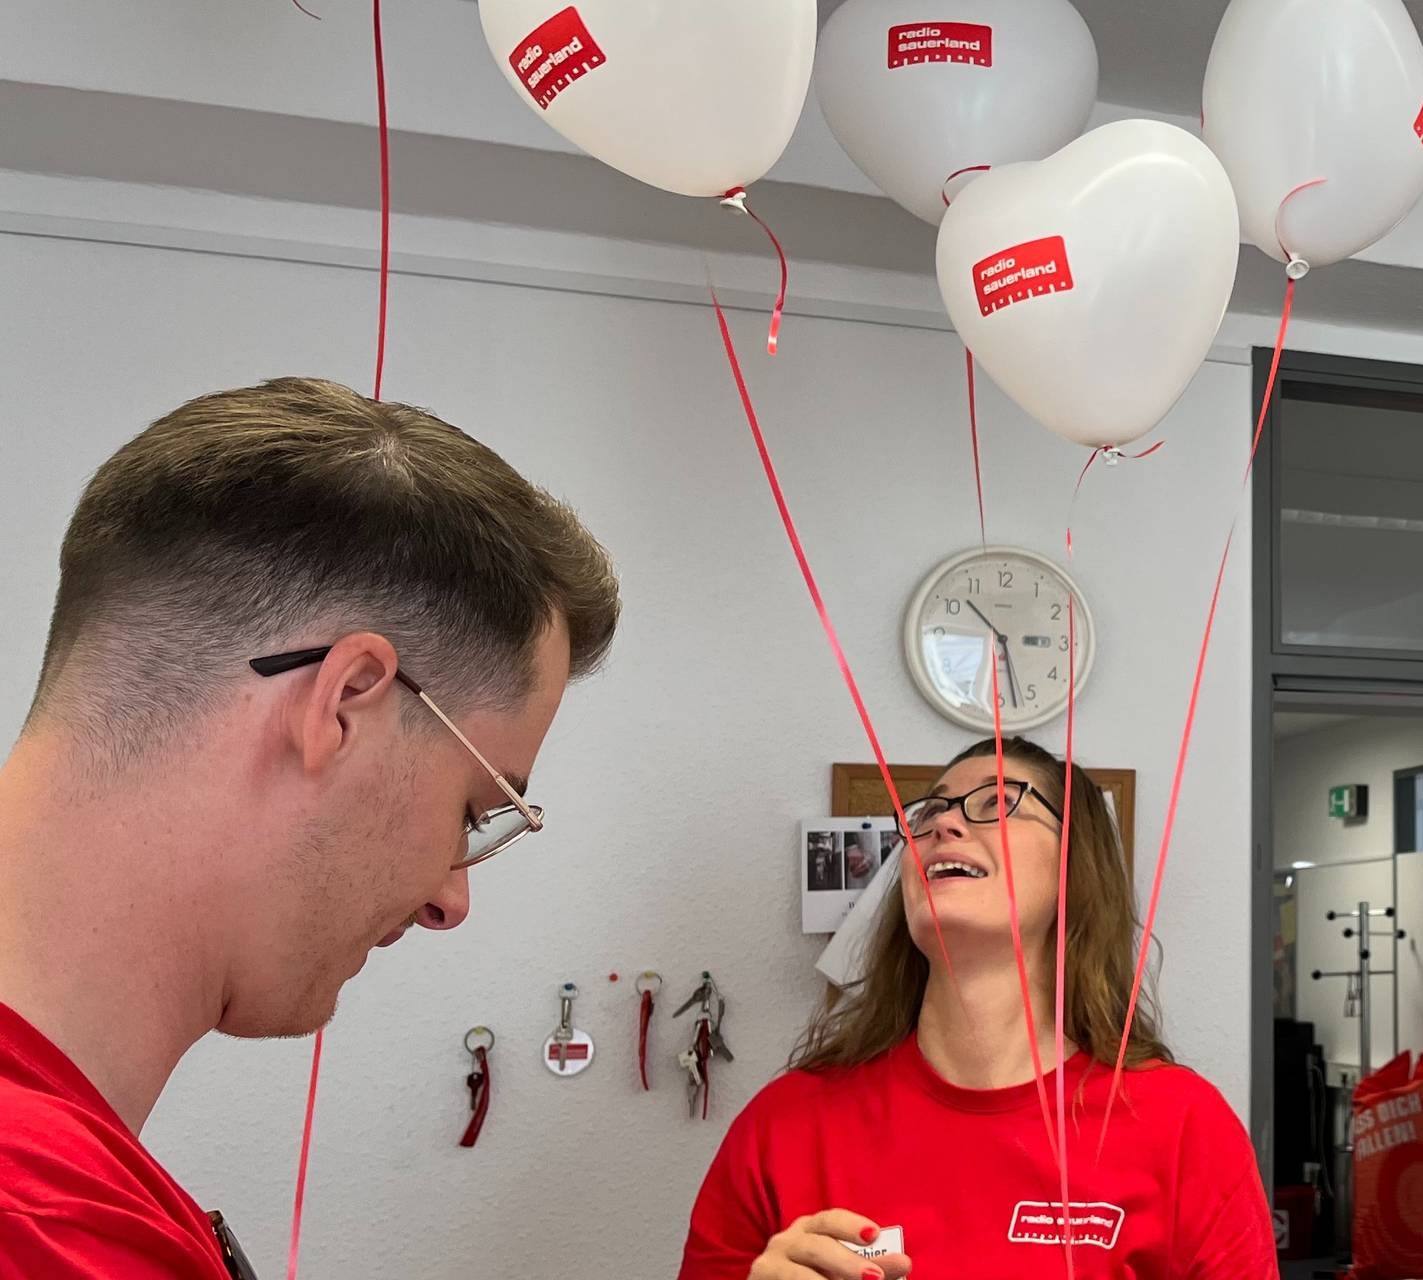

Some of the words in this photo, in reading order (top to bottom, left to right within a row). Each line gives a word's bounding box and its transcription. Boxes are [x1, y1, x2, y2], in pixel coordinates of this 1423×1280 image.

[898, 27, 941, 40] radio
[898, 37, 981, 52] sauerland
[517, 45, 543, 74] radio
[527, 36, 584, 89] sauerland
[980, 258, 1016, 281] radio
[983, 260, 1057, 295] sauerland
[967, 578, 981, 595] 11
[997, 571, 1013, 588] 12
[1034, 582, 1039, 598] 1
[944, 599, 961, 615] 10
[1050, 604, 1062, 620] 2
[1058, 635, 1069, 652] 3
[1047, 666, 1058, 681] 4
[1025, 684, 1036, 700] 5
[1020, 1214, 1054, 1225] radio
